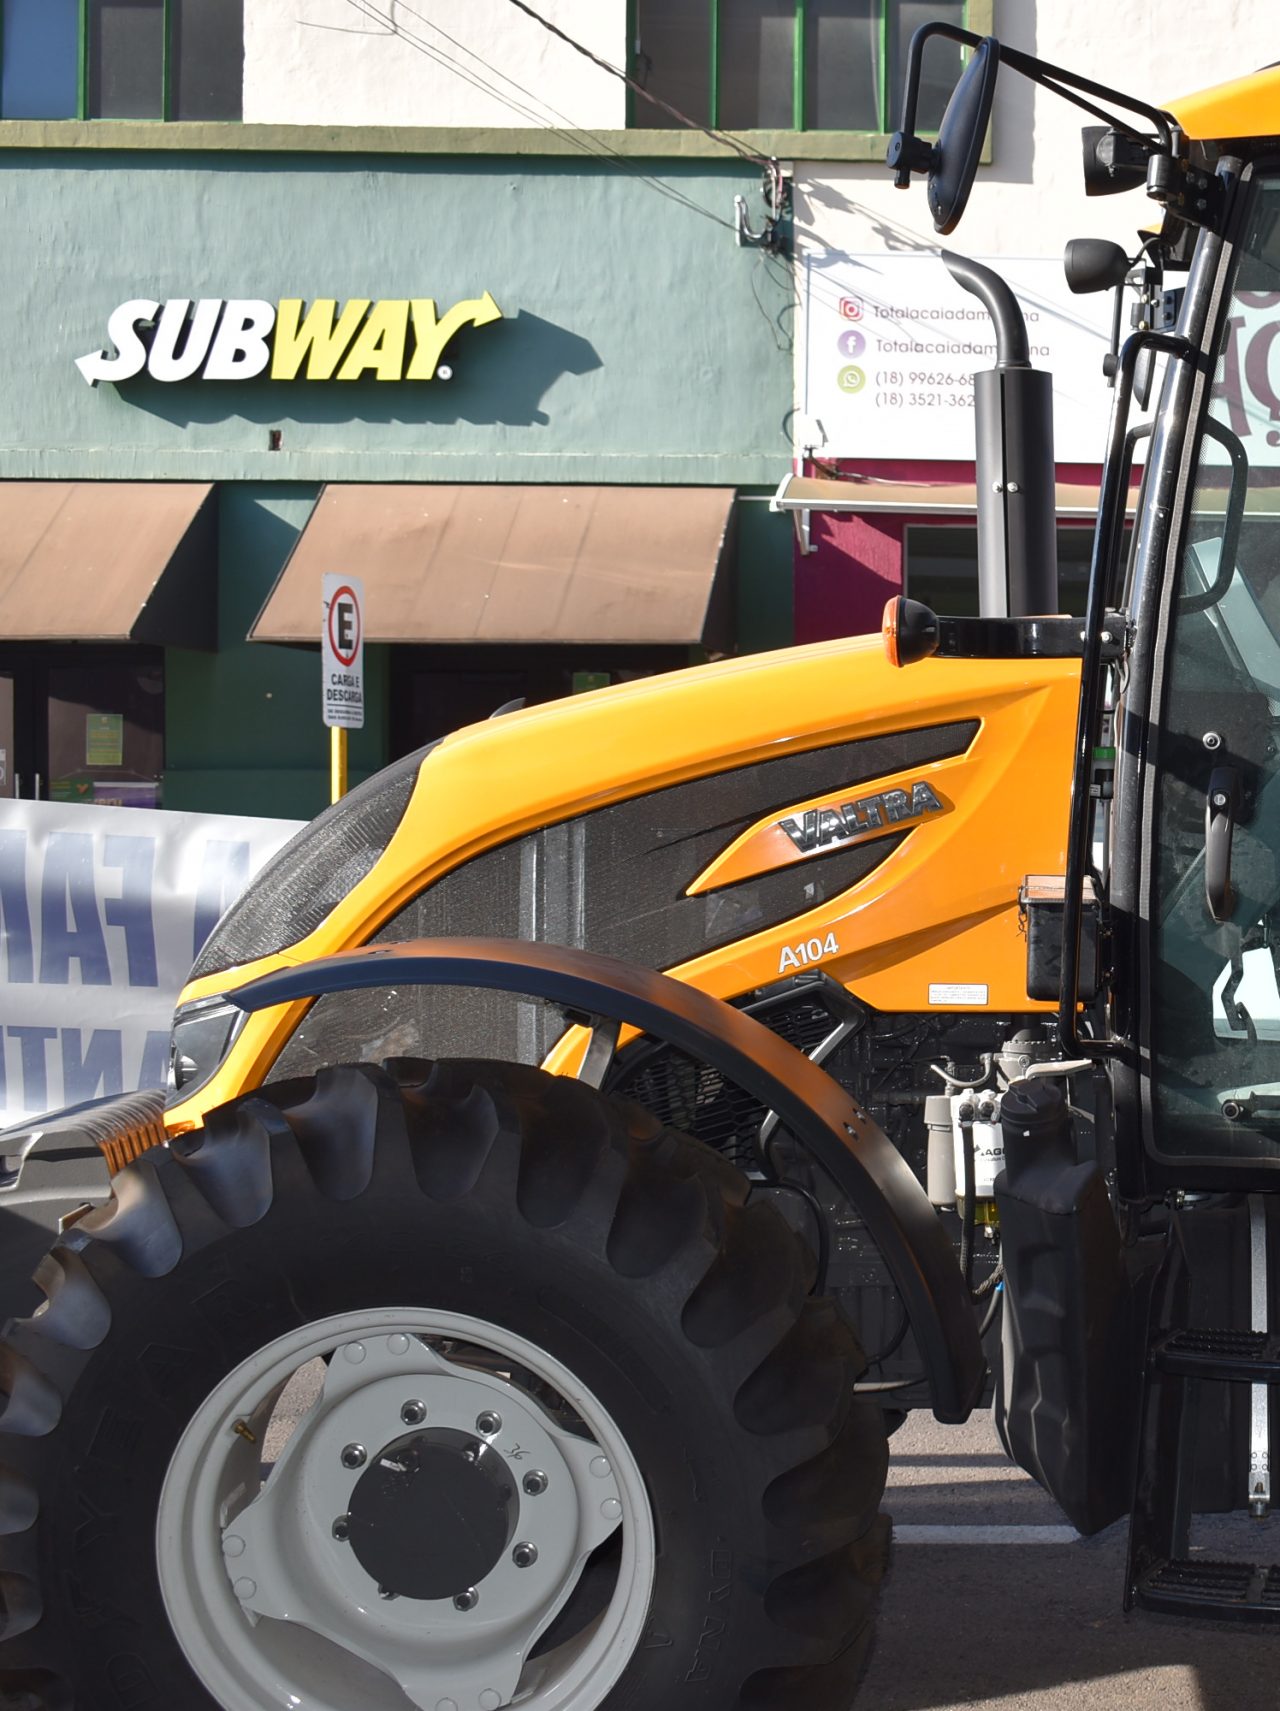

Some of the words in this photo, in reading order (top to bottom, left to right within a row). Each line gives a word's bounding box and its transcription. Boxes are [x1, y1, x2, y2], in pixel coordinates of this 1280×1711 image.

[74, 290, 502, 387] SUBWAY
[876, 371, 904, 388] (18)
[908, 371, 975, 386] 99626-68
[875, 392, 904, 408] (18)
[908, 393, 975, 407] 3521-362
[338, 602, 353, 650] E
[331, 673, 354, 687] CARGA
[326, 688, 362, 704] DESCARGA
[777, 781, 943, 853] VALTRA
[778, 932, 839, 974] A104
